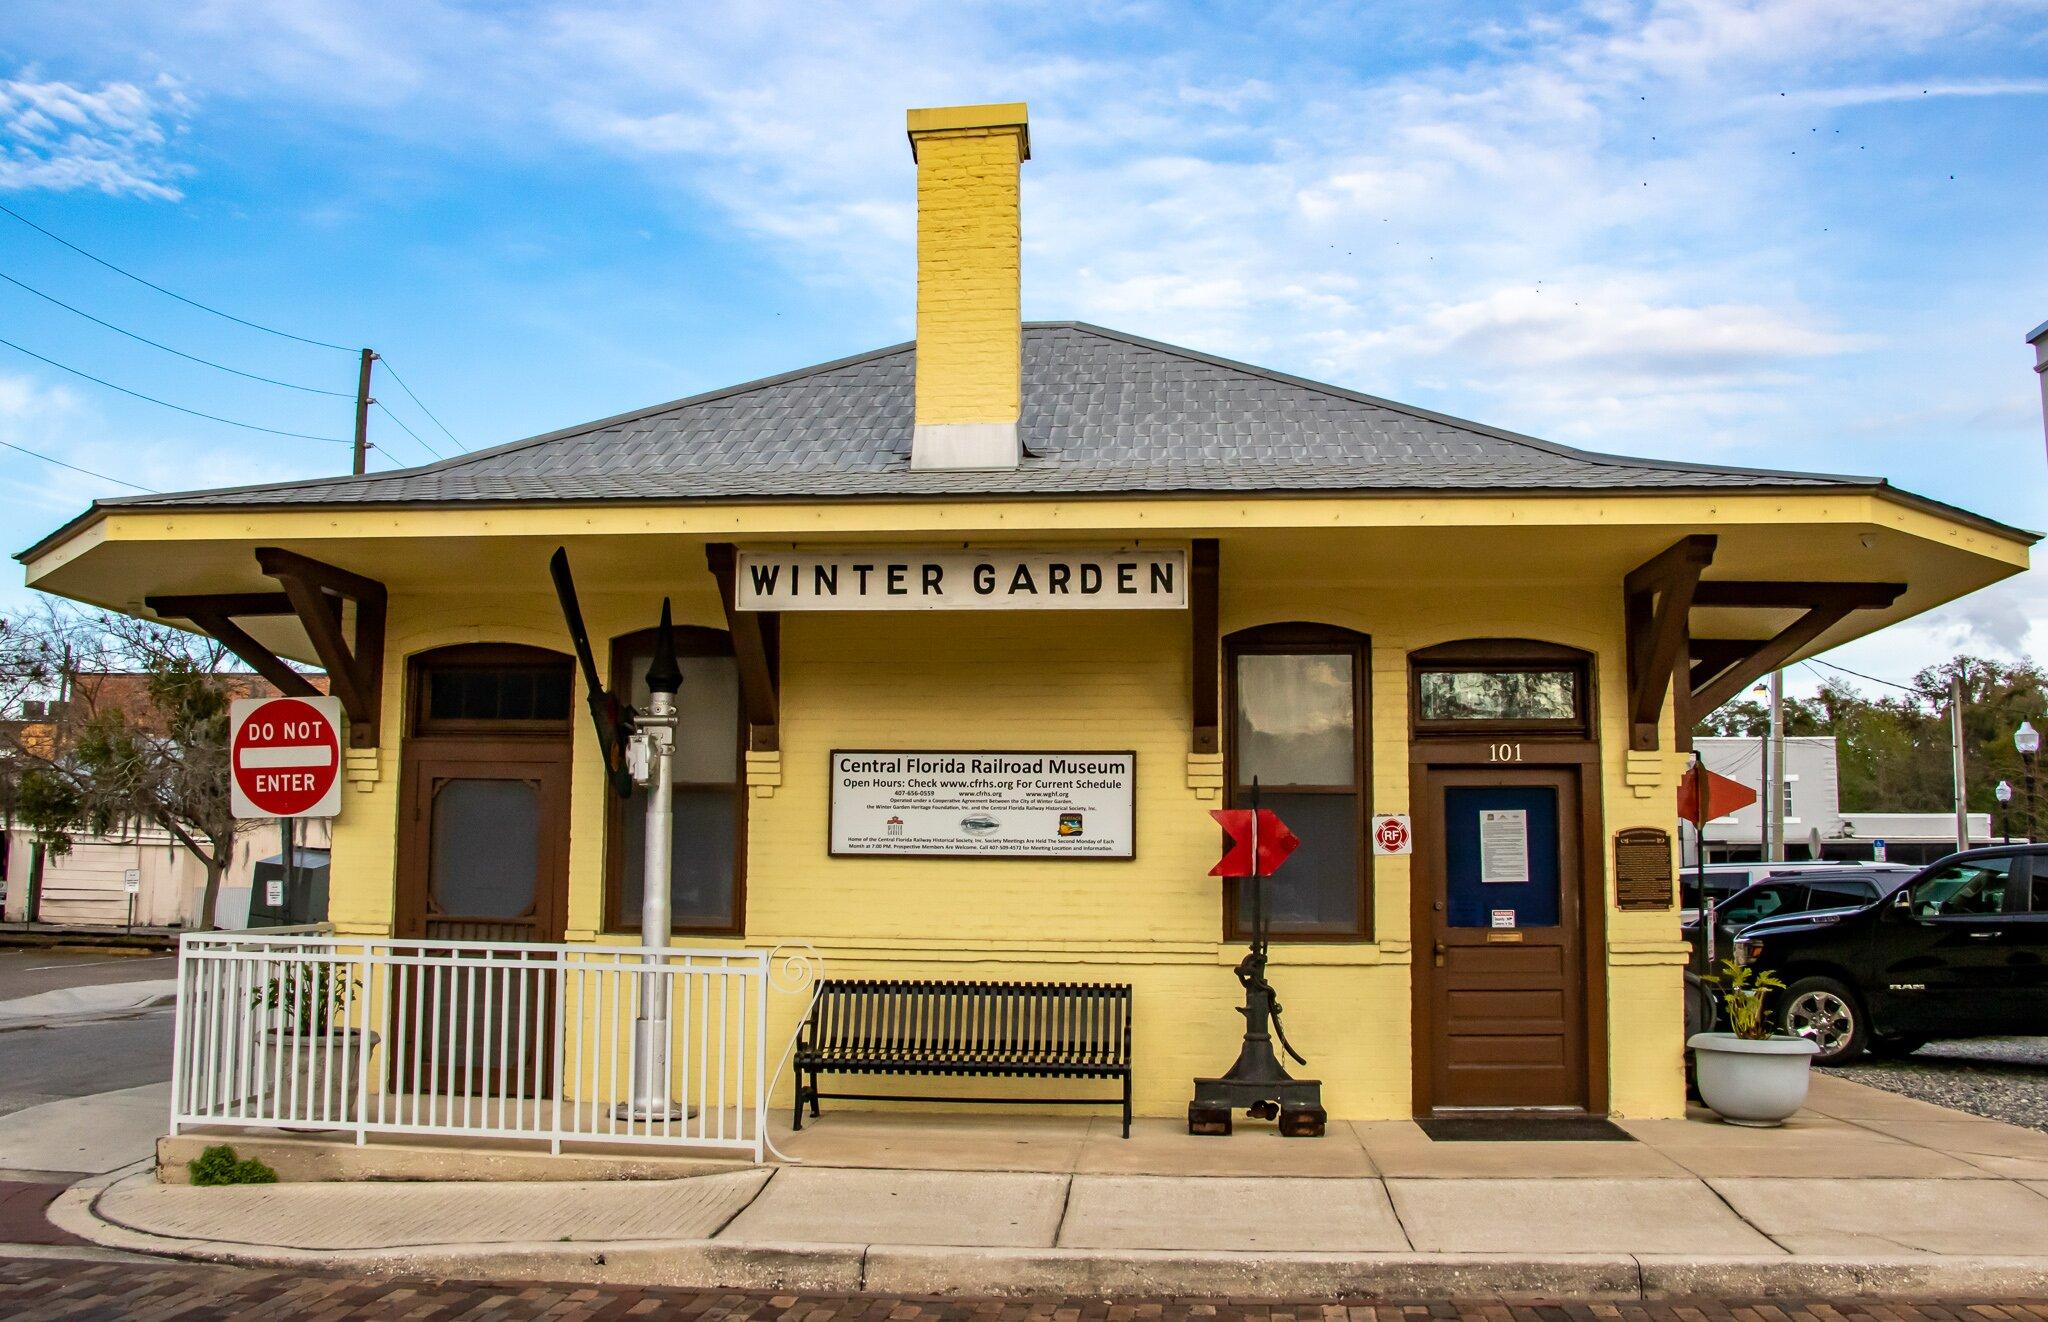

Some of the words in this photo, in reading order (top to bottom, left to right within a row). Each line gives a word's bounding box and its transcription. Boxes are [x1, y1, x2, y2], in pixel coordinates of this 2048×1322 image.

[750, 564, 944, 596] WINTER
[973, 562, 1173, 594] GARDEN
[249, 722, 274, 740] DO
[284, 722, 322, 740] NOT
[1490, 744, 1522, 761] 101
[840, 758, 900, 772] Central
[907, 759, 965, 773] Florida
[972, 759, 1042, 773] Railroad
[1049, 760, 1125, 774] Museum
[256, 774, 315, 792] ENTER
[843, 778, 870, 789] Open
[873, 779, 905, 787] Hours:
[908, 779, 937, 788] Check
[940, 779, 1013, 790] www.cfrhs.org
[1017, 779, 1032, 788] For
[1035, 780, 1073, 788] Current
[1076, 780, 1122, 788] Schedule
[1384, 830, 1400, 840] RF
